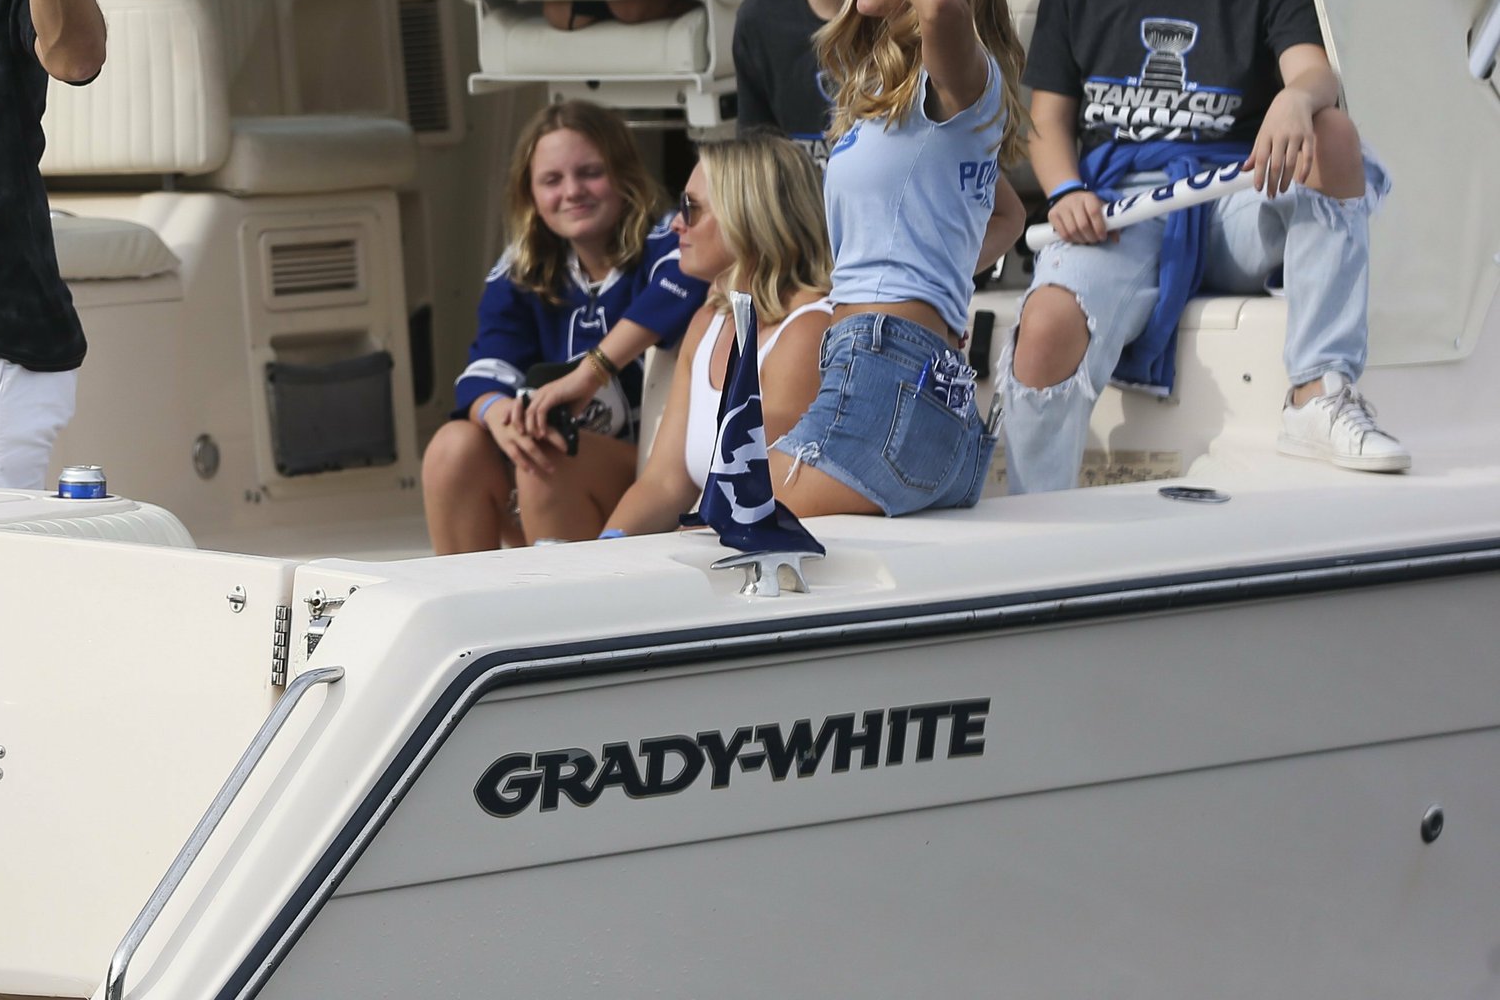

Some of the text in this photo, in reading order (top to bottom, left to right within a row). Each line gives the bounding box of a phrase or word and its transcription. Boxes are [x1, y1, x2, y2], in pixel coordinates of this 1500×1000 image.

[1083, 82, 1243, 117] STANLEY CUP
[473, 697, 991, 819] GRADY-WHITE
